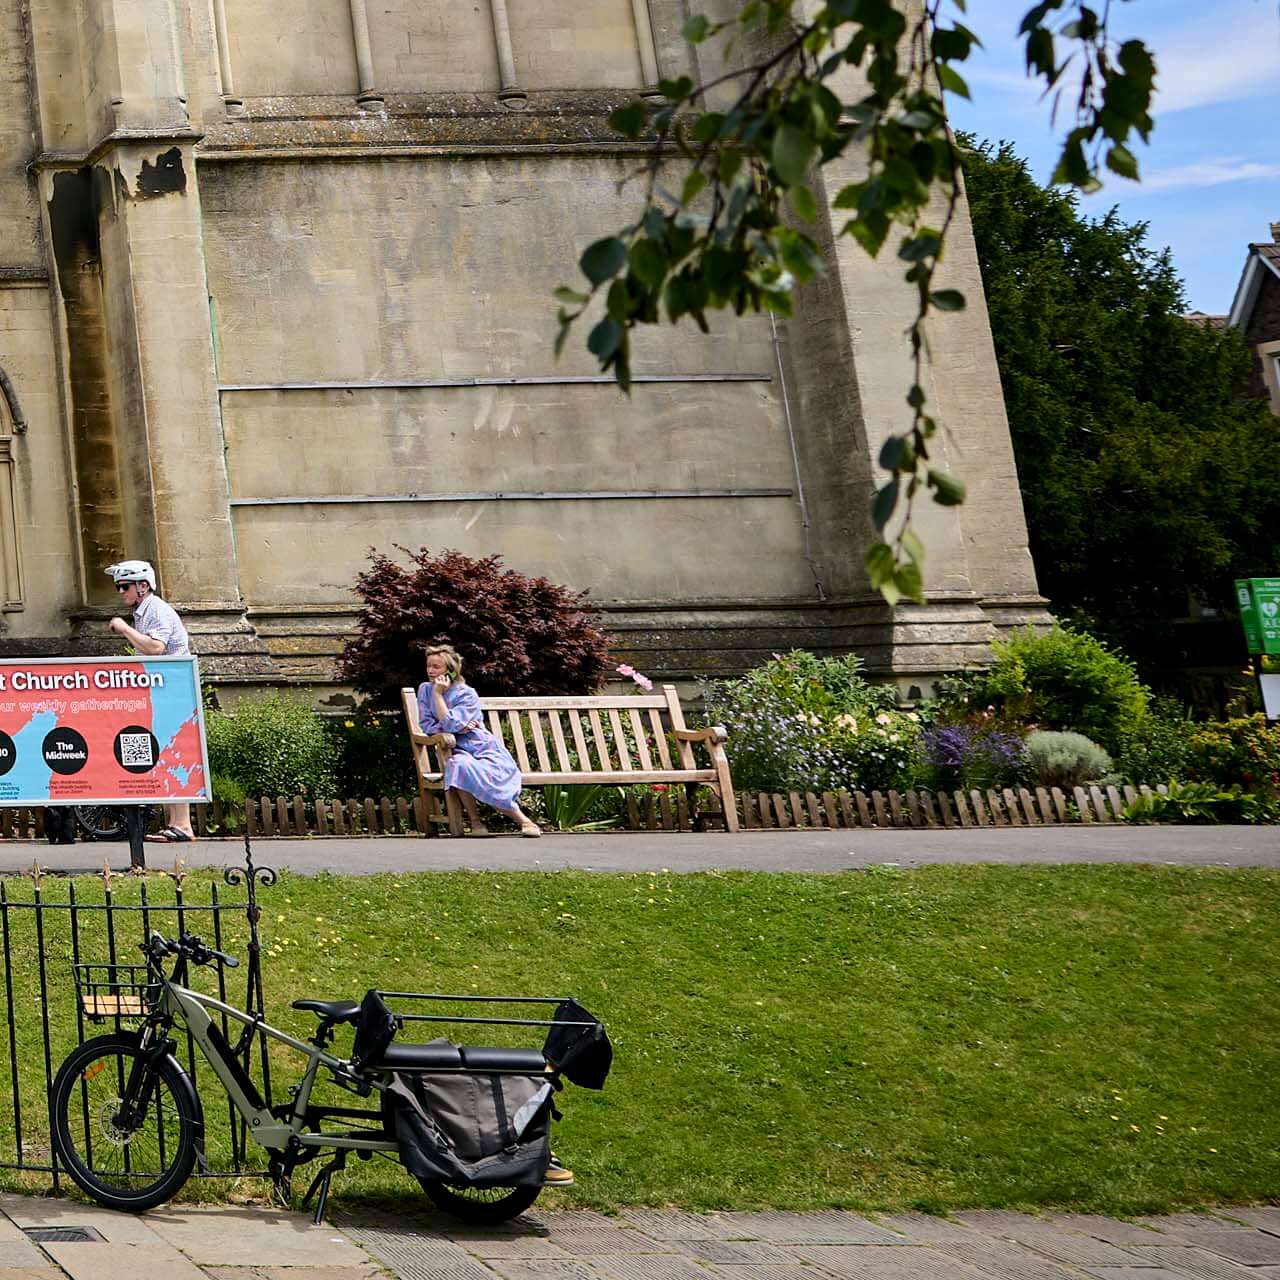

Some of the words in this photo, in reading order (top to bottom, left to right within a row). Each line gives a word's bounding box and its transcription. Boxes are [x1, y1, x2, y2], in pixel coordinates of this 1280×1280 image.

[12, 671, 89, 690] Church
[94, 670, 164, 689] Clifton
[56, 742, 73, 751] The
[45, 751, 87, 760] Midweek
